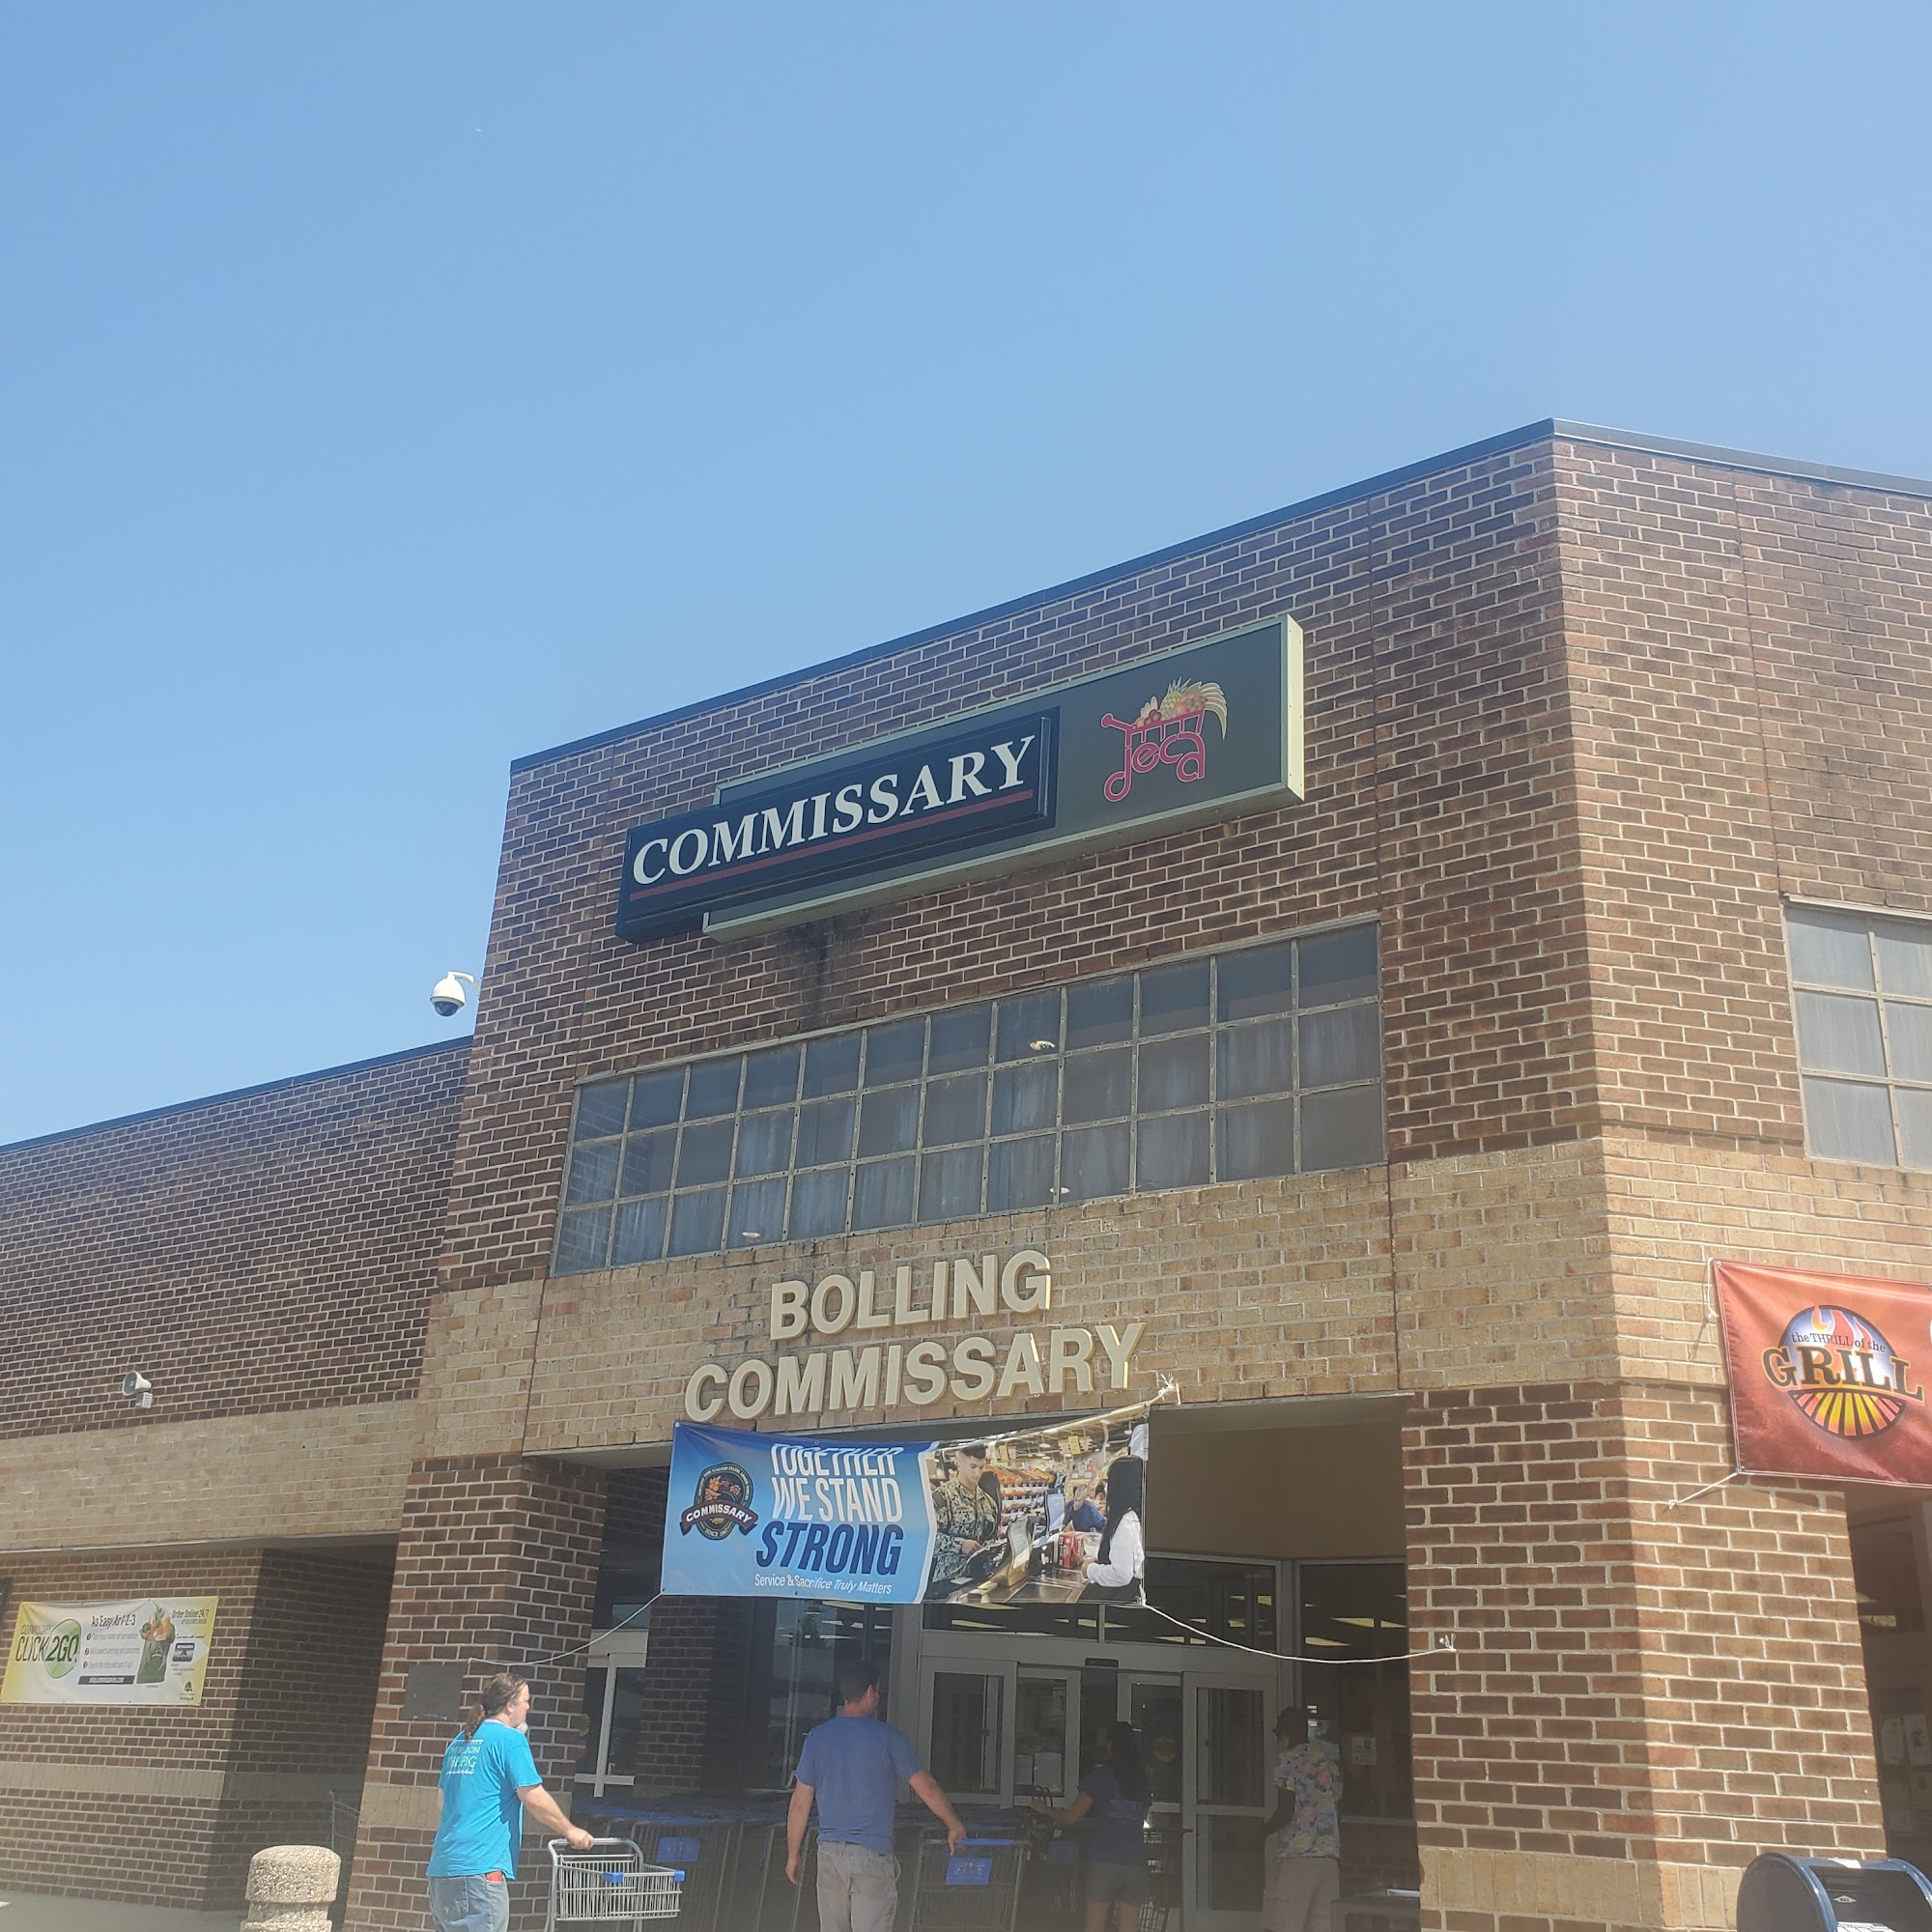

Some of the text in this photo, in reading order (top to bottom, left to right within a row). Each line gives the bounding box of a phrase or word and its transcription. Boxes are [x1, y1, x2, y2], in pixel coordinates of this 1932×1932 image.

[632, 735, 1036, 886] COMMISSARY
[770, 1249, 1051, 1341] BOLLING
[1792, 1332, 1886, 1352] the THRILL of the
[684, 1321, 1147, 1422] COMMISSARY
[1762, 1345, 1925, 1404] GRILL
[771, 1443, 904, 1476] TOGETHER
[686, 1503, 753, 1523] COMMISSARY
[772, 1477, 903, 1522] WE STAND
[755, 1520, 904, 1576] STRONG
[754, 1574, 893, 1594] Service & Sacrifice Truly Matters
[91, 1613, 136, 1630] As Easy As 1-2-3
[171, 1609, 185, 1619] Order
